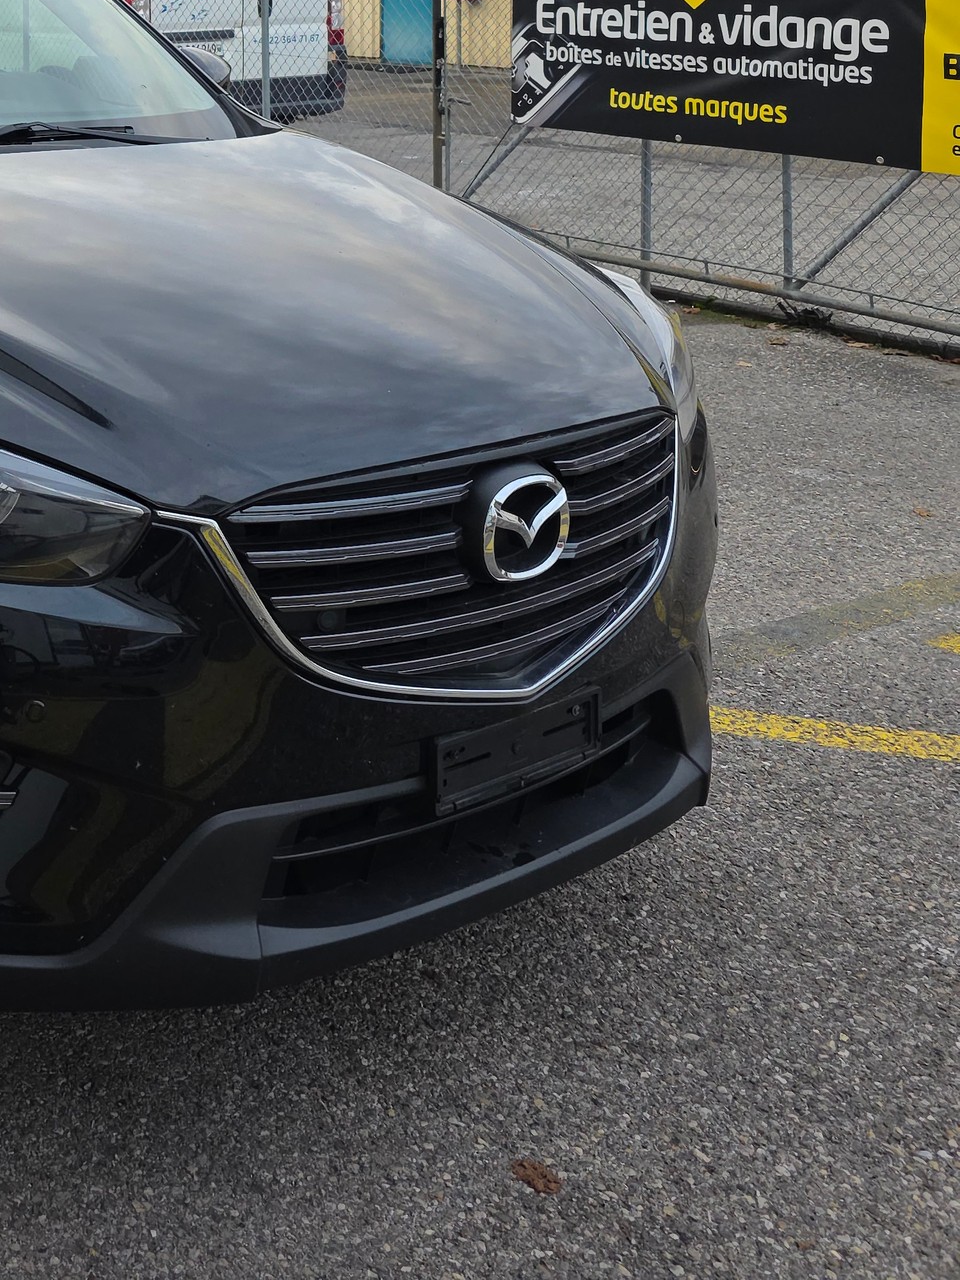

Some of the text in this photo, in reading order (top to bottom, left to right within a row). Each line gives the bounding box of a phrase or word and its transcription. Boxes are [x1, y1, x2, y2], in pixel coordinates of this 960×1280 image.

[698, 22, 715, 45] &
[717, 4, 890, 62] vidange
[546, 41, 873, 87] boîtes de vitesses automatiques
[609, 87, 788, 125] toutes marques
